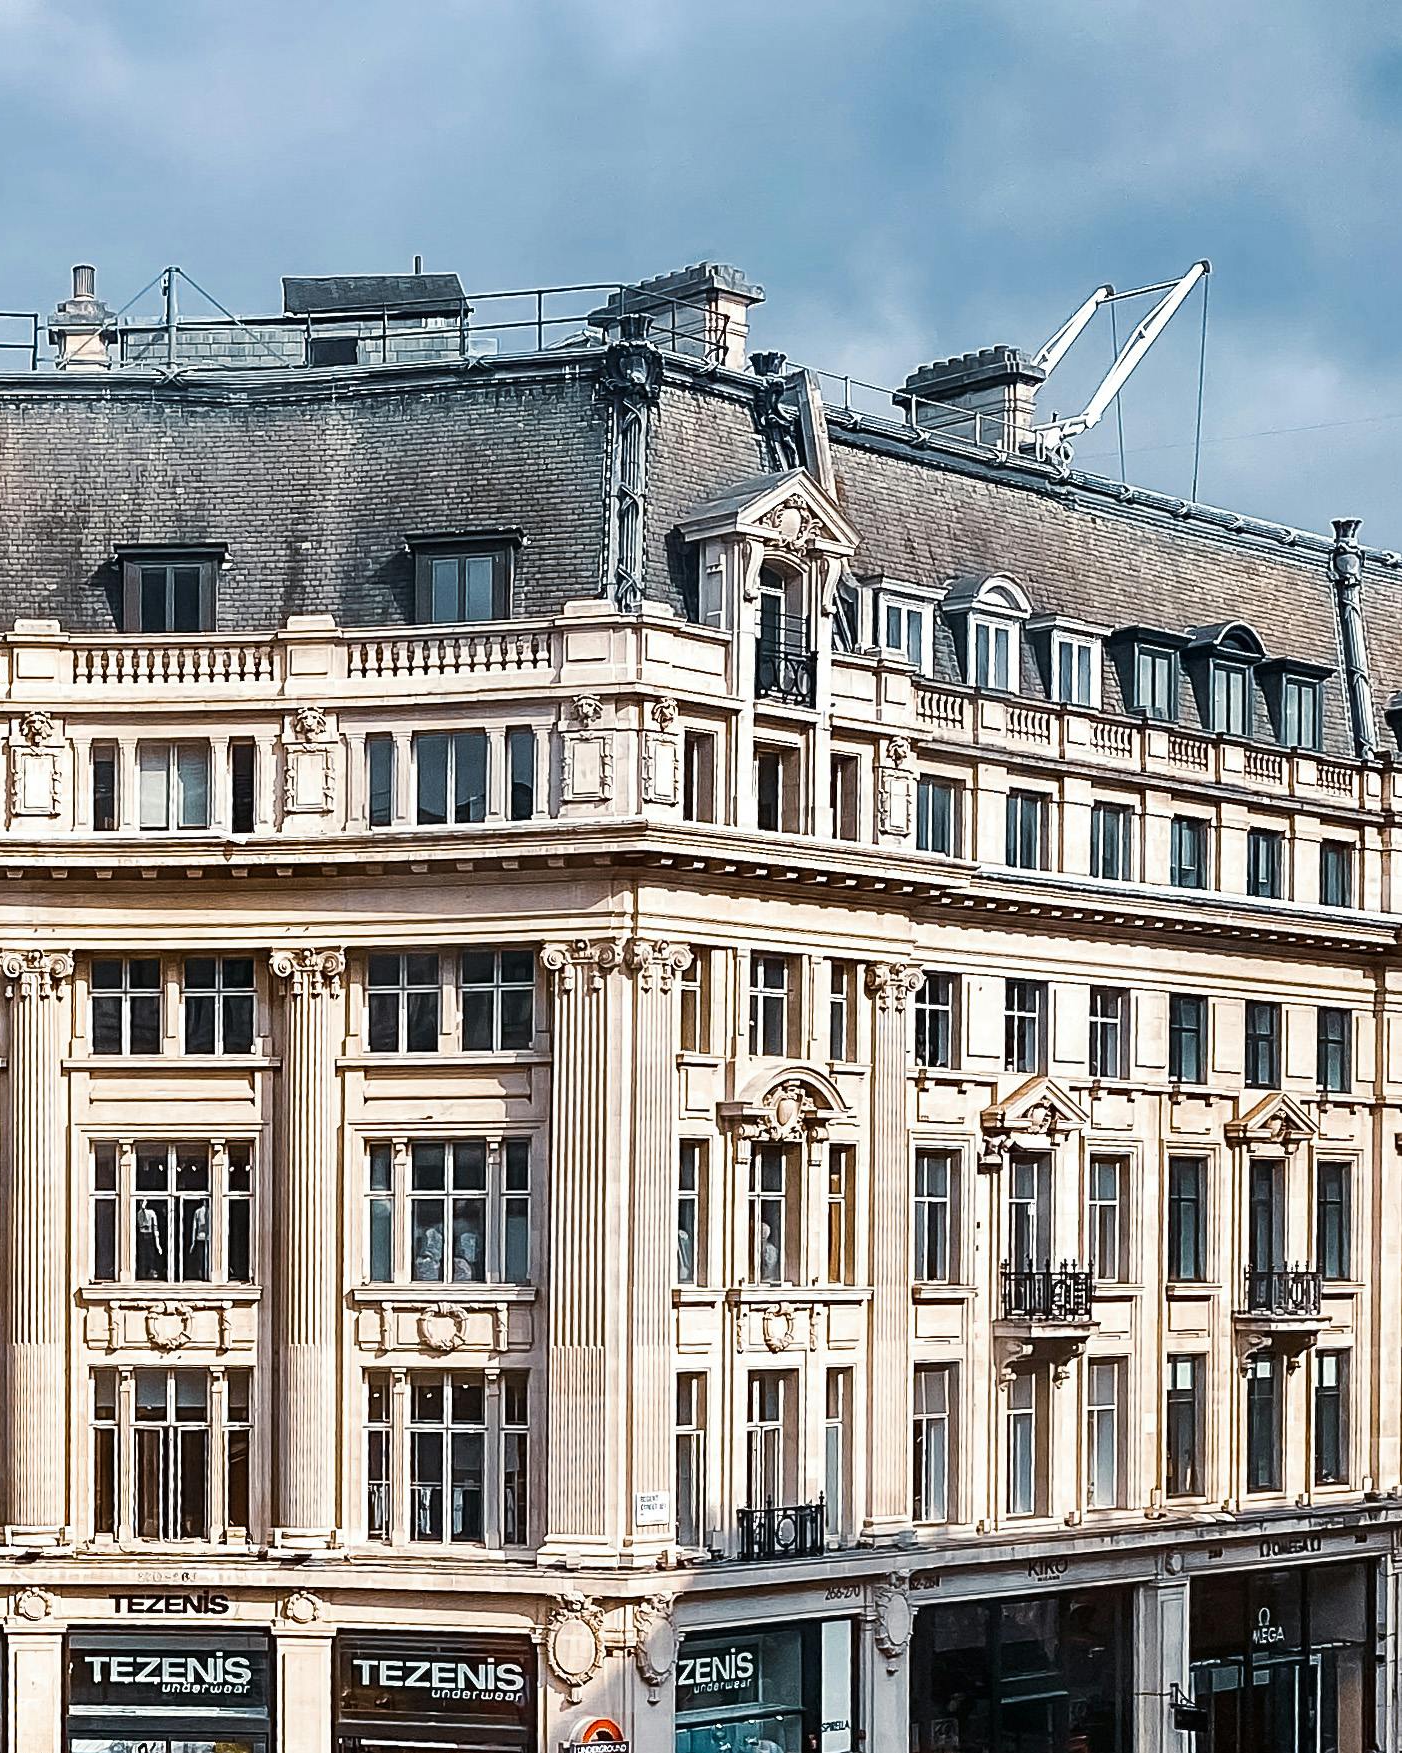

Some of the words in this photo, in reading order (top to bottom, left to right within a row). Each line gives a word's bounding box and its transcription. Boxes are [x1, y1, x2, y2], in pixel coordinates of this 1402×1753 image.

[108, 1590, 230, 1615] TEZENIS
[85, 1652, 253, 1685] TEZENIS
[352, 1658, 525, 1690] TEZENIS
[676, 1651, 754, 1687] ZENIS
[161, 1683, 252, 1695] underwear
[431, 1688, 524, 1701] underwear
[693, 1678, 753, 1694] underwear
